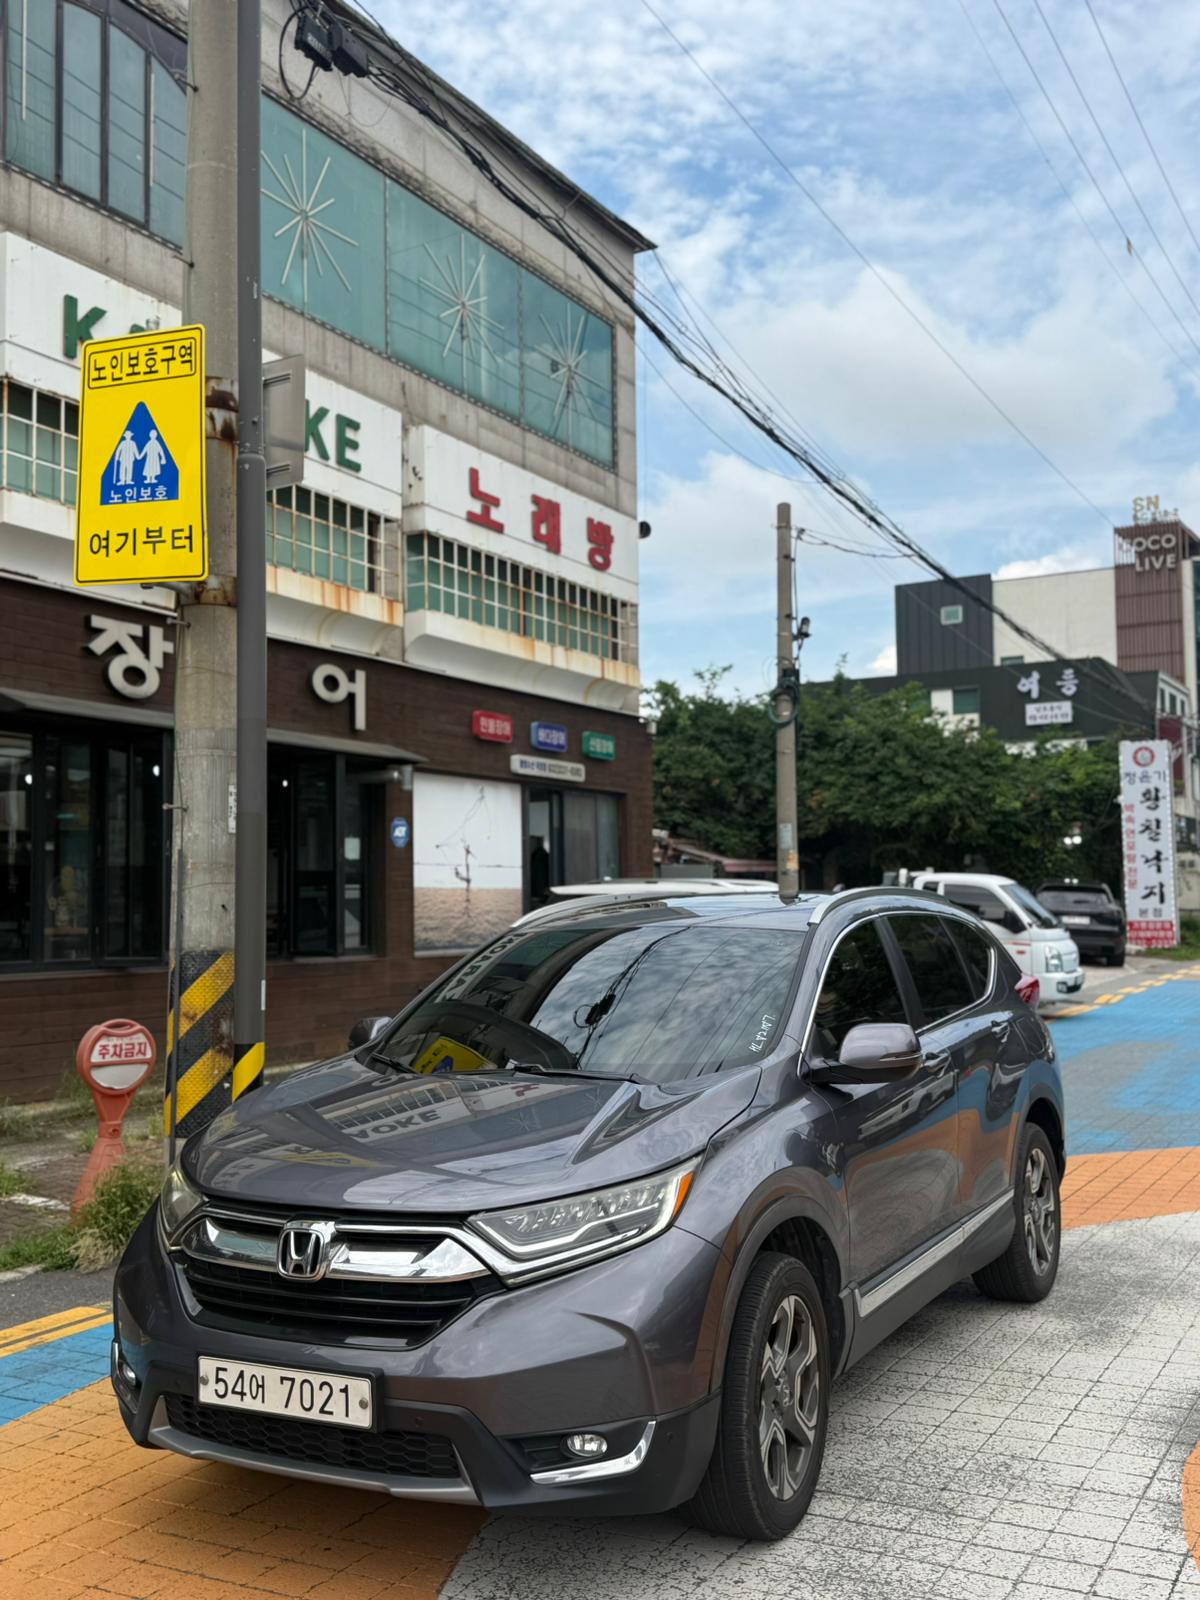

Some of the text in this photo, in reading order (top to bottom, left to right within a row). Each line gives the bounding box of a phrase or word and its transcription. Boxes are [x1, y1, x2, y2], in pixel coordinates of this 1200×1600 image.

[91, 341, 193, 382] 노인보호구역
[109, 485, 168, 503] 노인보호
[466, 467, 614, 572] 노래방
[89, 525, 194, 557] 여기부터
[1135, 552, 1177, 573] LIVE
[98, 1042, 147, 1059] 주차금지
[213, 1366, 351, 1418] 54어 7021
